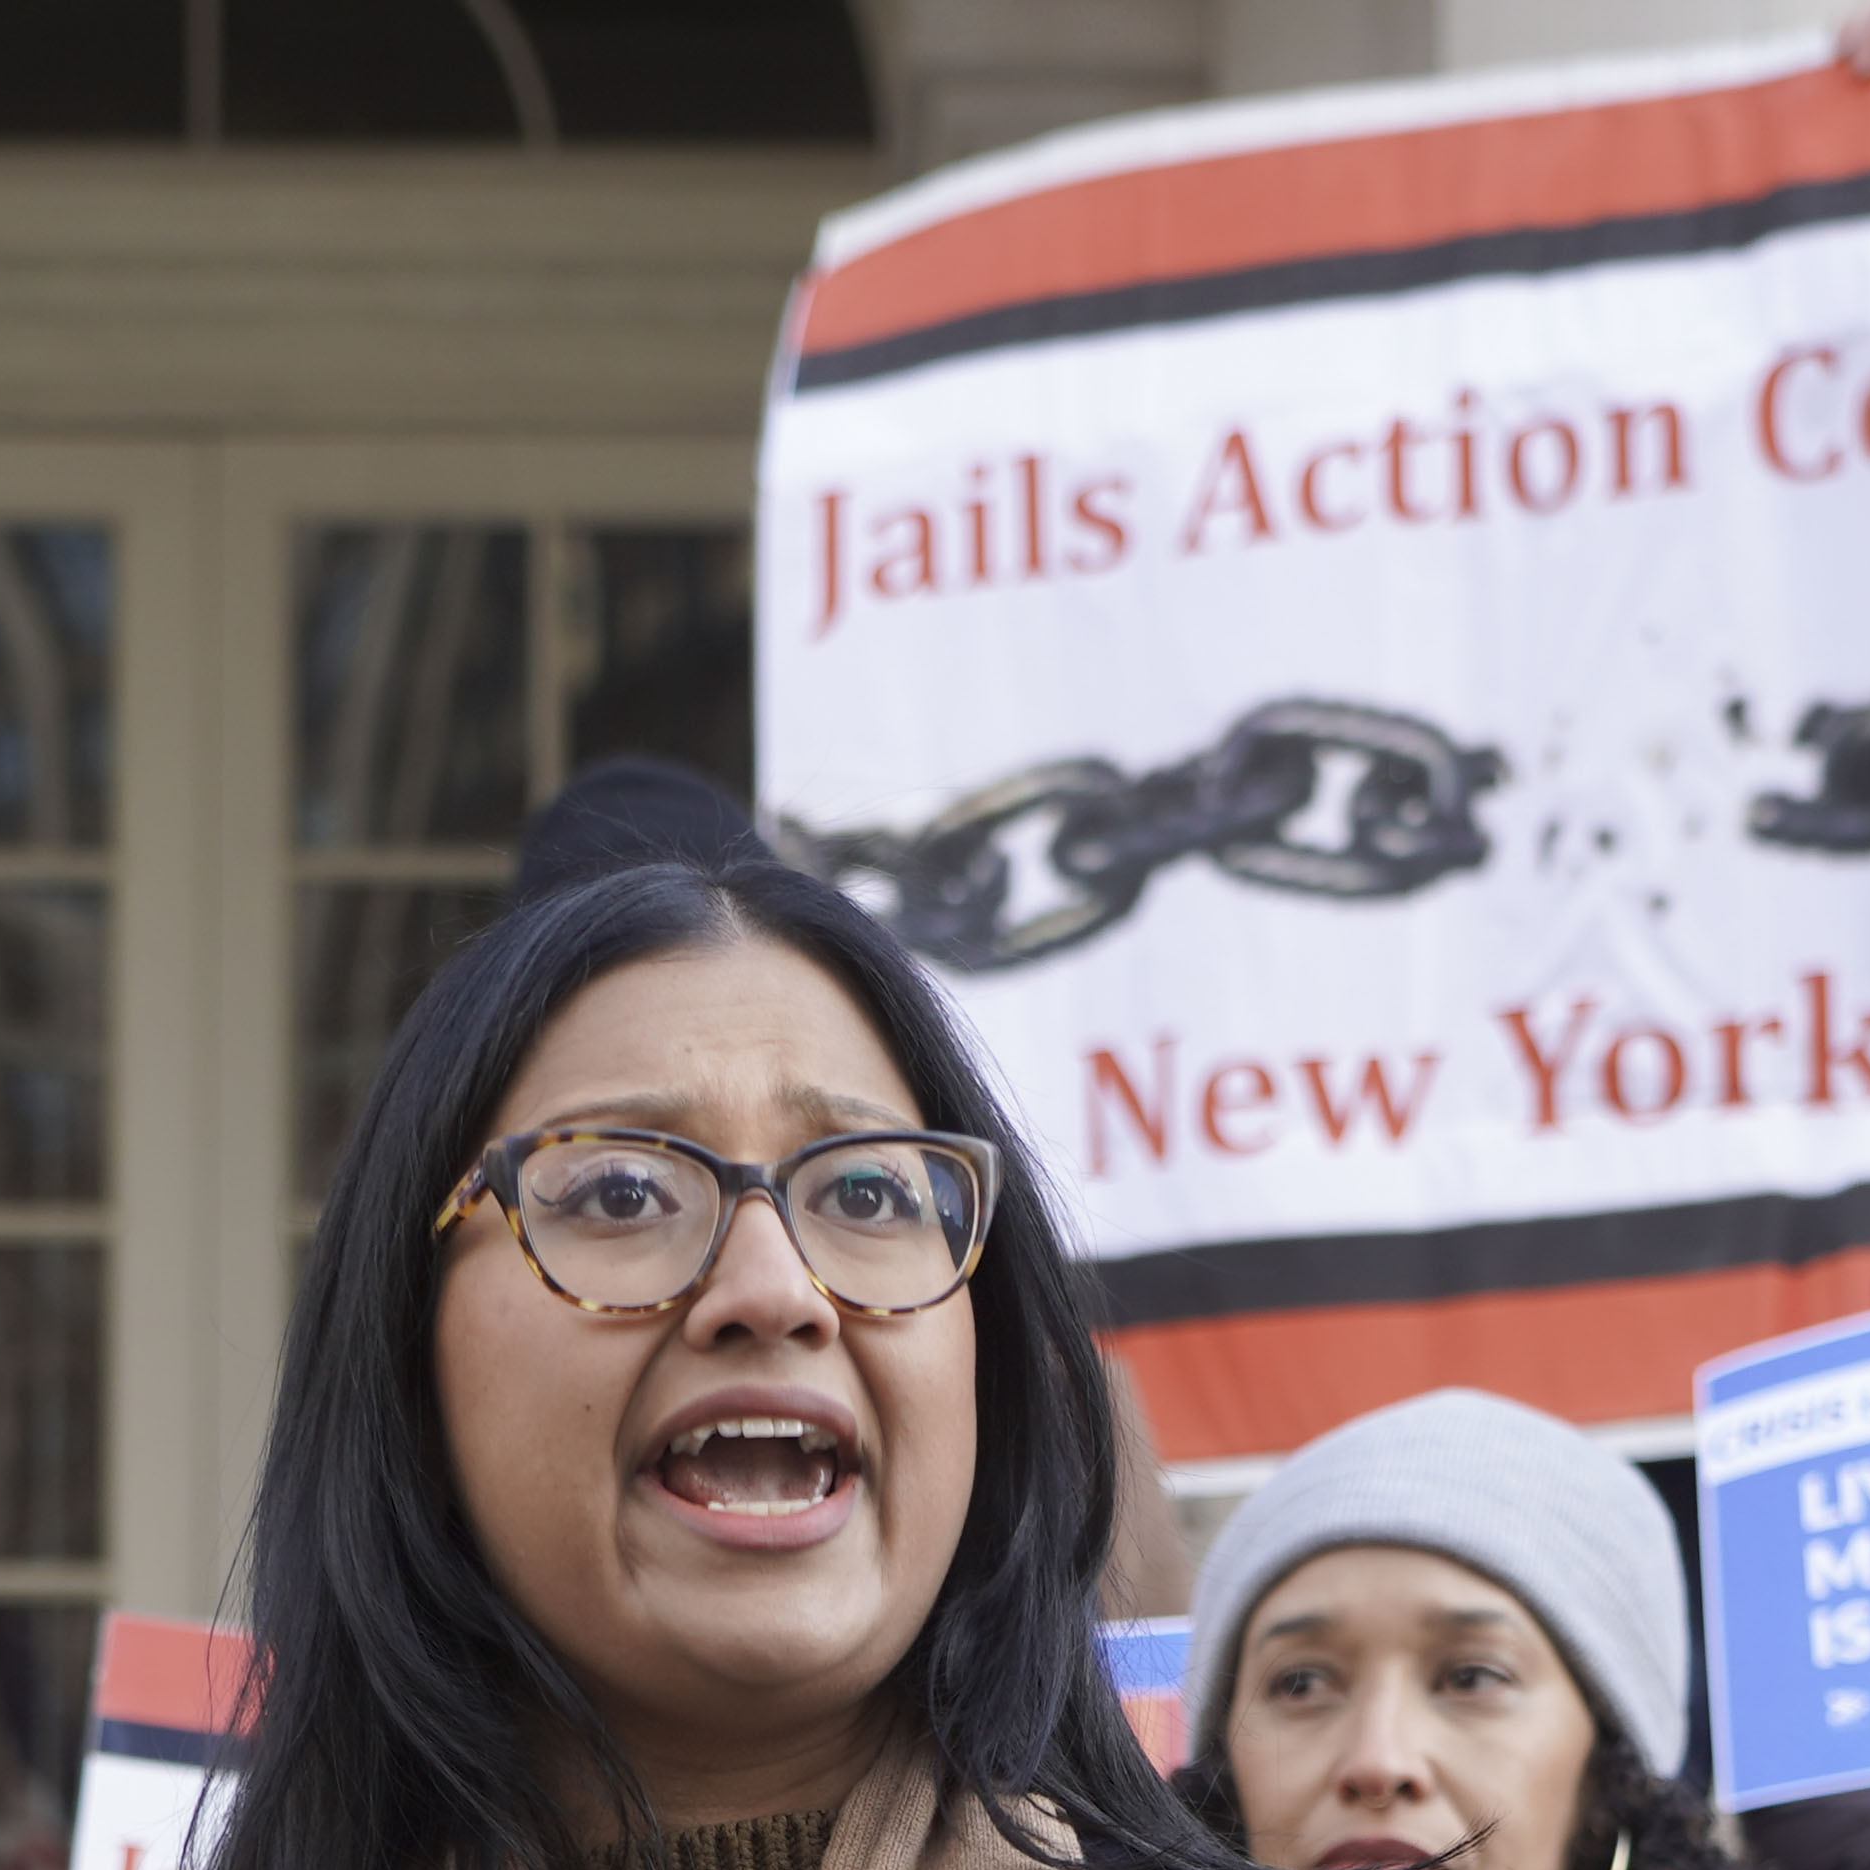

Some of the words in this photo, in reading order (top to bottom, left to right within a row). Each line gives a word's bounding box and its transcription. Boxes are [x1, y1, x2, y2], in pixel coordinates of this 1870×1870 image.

[809, 450, 1136, 644] Jails
[1179, 387, 1693, 556] Action
[1082, 1032, 1443, 1182] New
